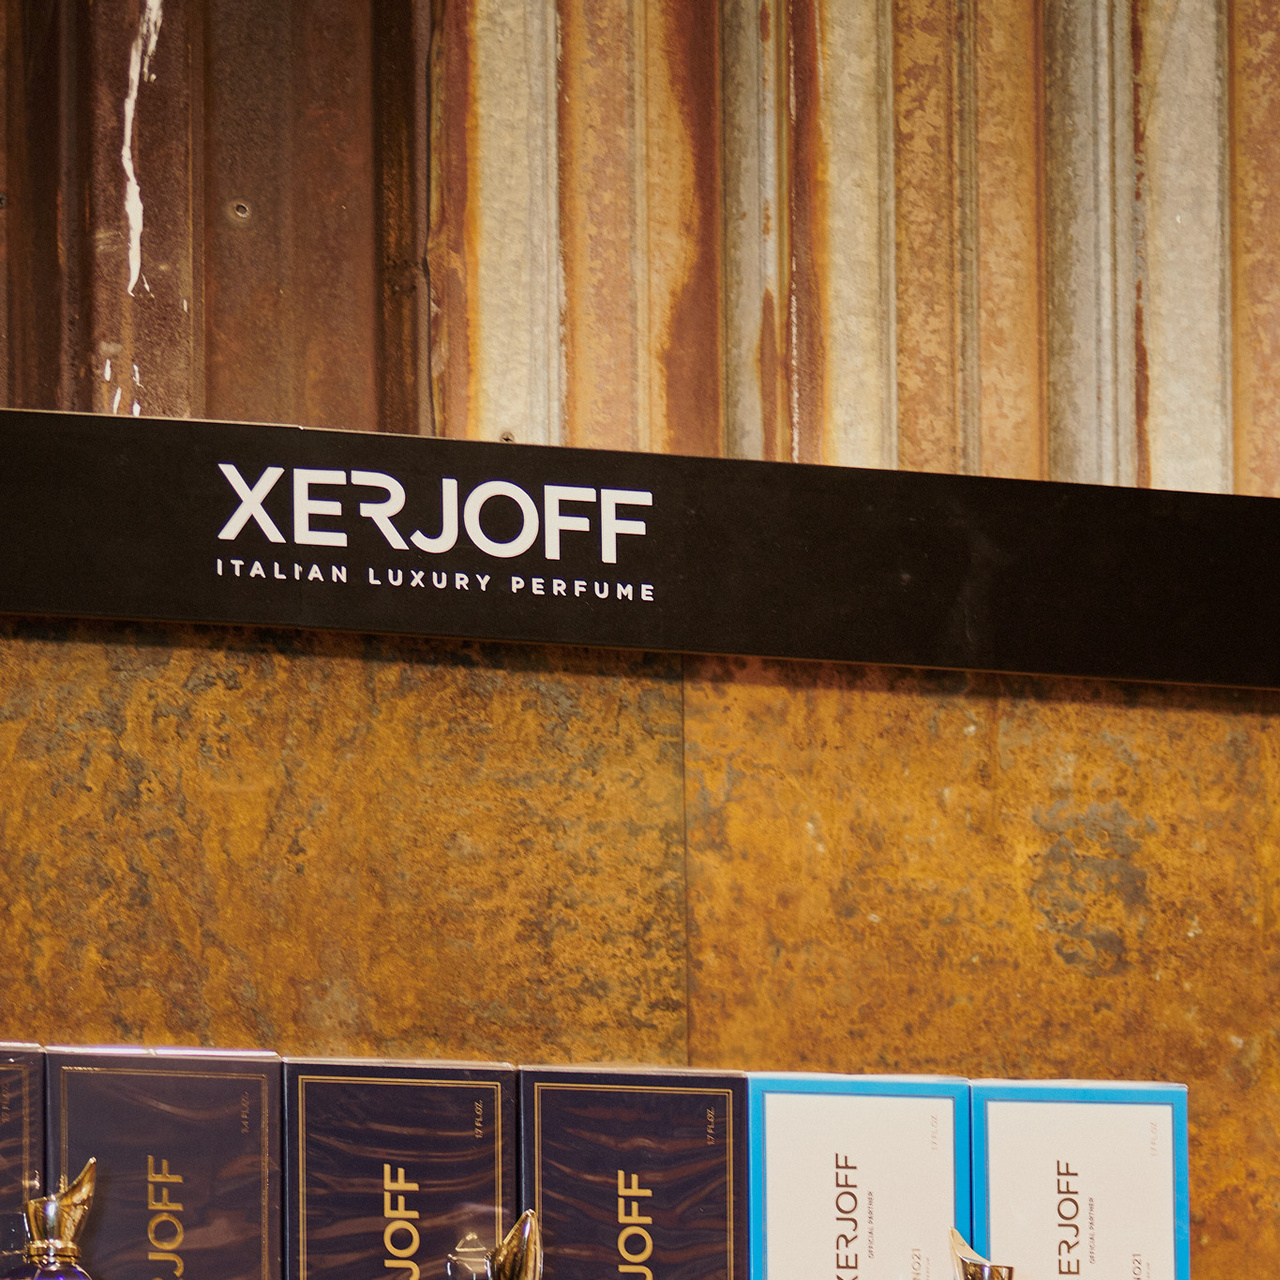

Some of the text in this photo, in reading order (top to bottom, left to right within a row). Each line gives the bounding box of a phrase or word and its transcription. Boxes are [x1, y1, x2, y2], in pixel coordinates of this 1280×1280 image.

[217, 462, 654, 564] XERJOFF
[216, 558, 656, 603] ITALIAN LUXURY PERFUME
